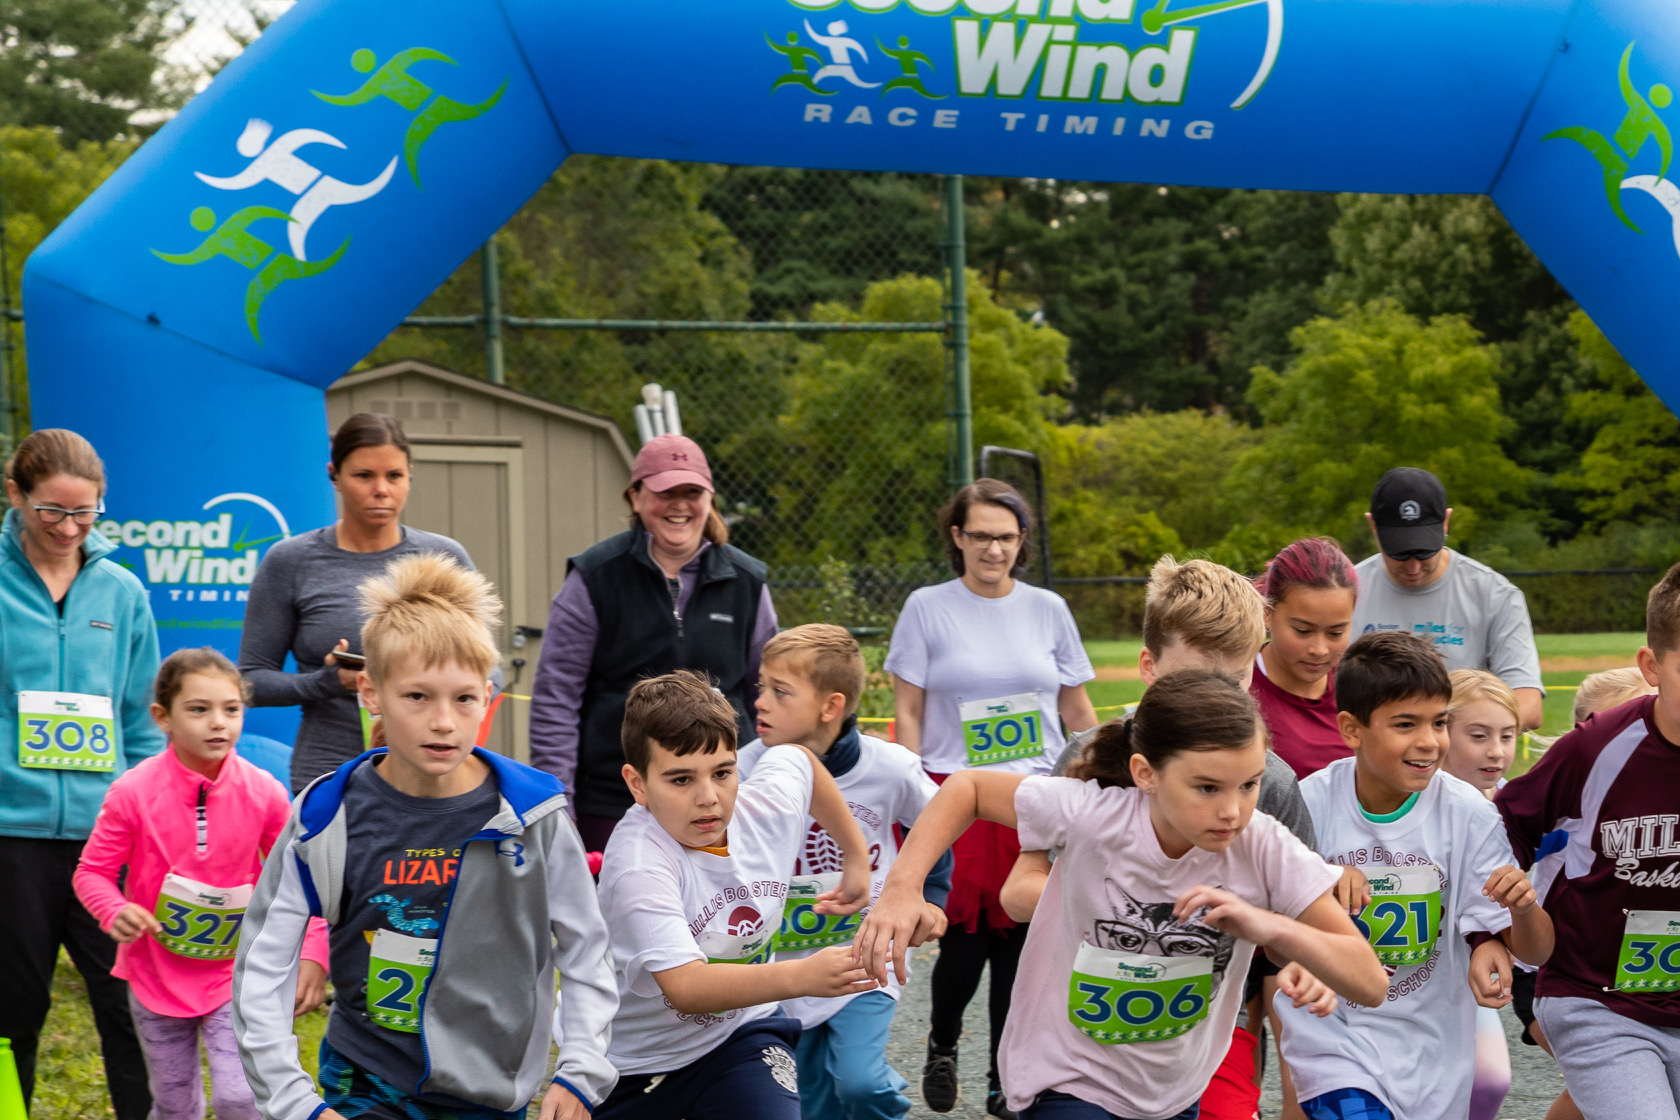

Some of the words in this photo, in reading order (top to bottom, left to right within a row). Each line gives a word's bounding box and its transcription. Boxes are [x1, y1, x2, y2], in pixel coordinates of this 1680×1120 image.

[953, 17, 1198, 104] Wind
[804, 104, 959, 128] RACE
[1000, 112, 1215, 140] TIMING
[103, 513, 232, 548] econd
[144, 549, 258, 584] Wind
[169, 590, 249, 602] TIMIN
[25, 719, 110, 754] 308
[969, 716, 1038, 752] 301
[405, 848, 446, 857] TYPES
[384, 859, 460, 885] LIZAR
[160, 901, 245, 946] 327
[1073, 981, 1206, 1026] 306
